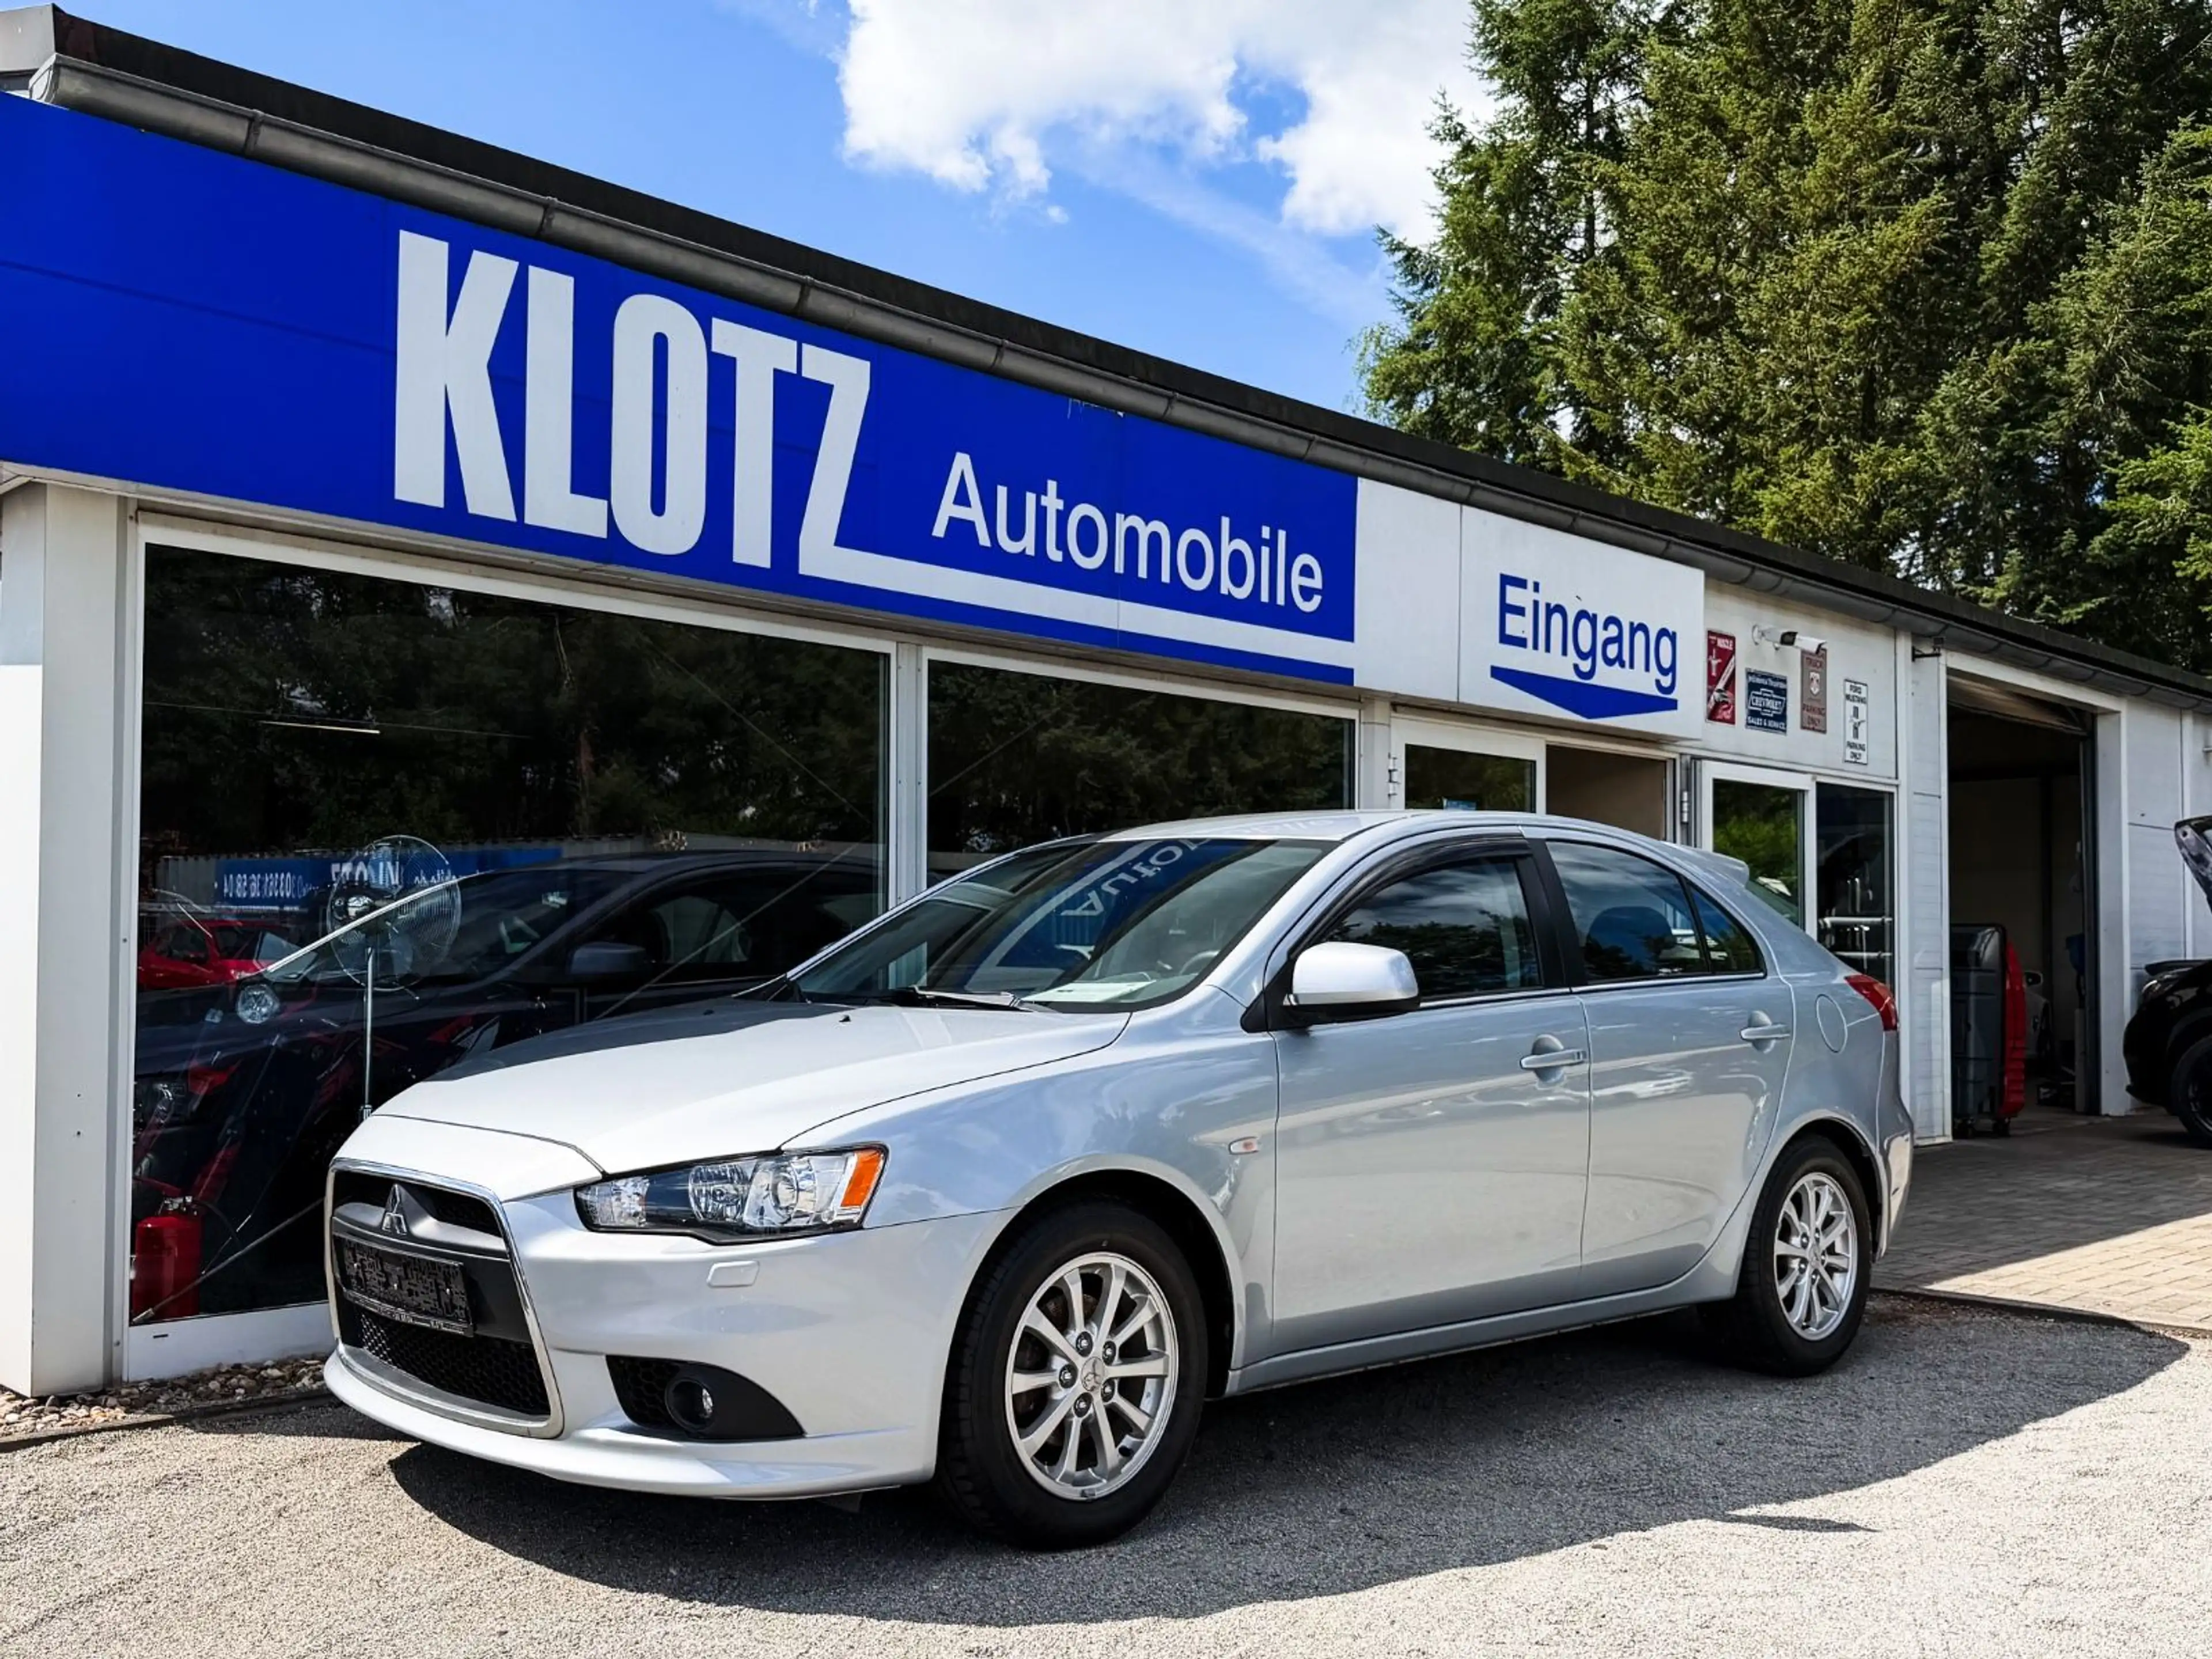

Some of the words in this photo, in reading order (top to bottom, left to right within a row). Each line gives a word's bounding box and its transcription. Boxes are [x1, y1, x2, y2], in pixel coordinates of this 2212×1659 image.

[395, 229, 871, 576] KLOTZ
[931, 452, 1323, 612] Automobile
[1499, 573, 1677, 695] Eingang
[1752, 696, 1782, 710] CHEVROLET
